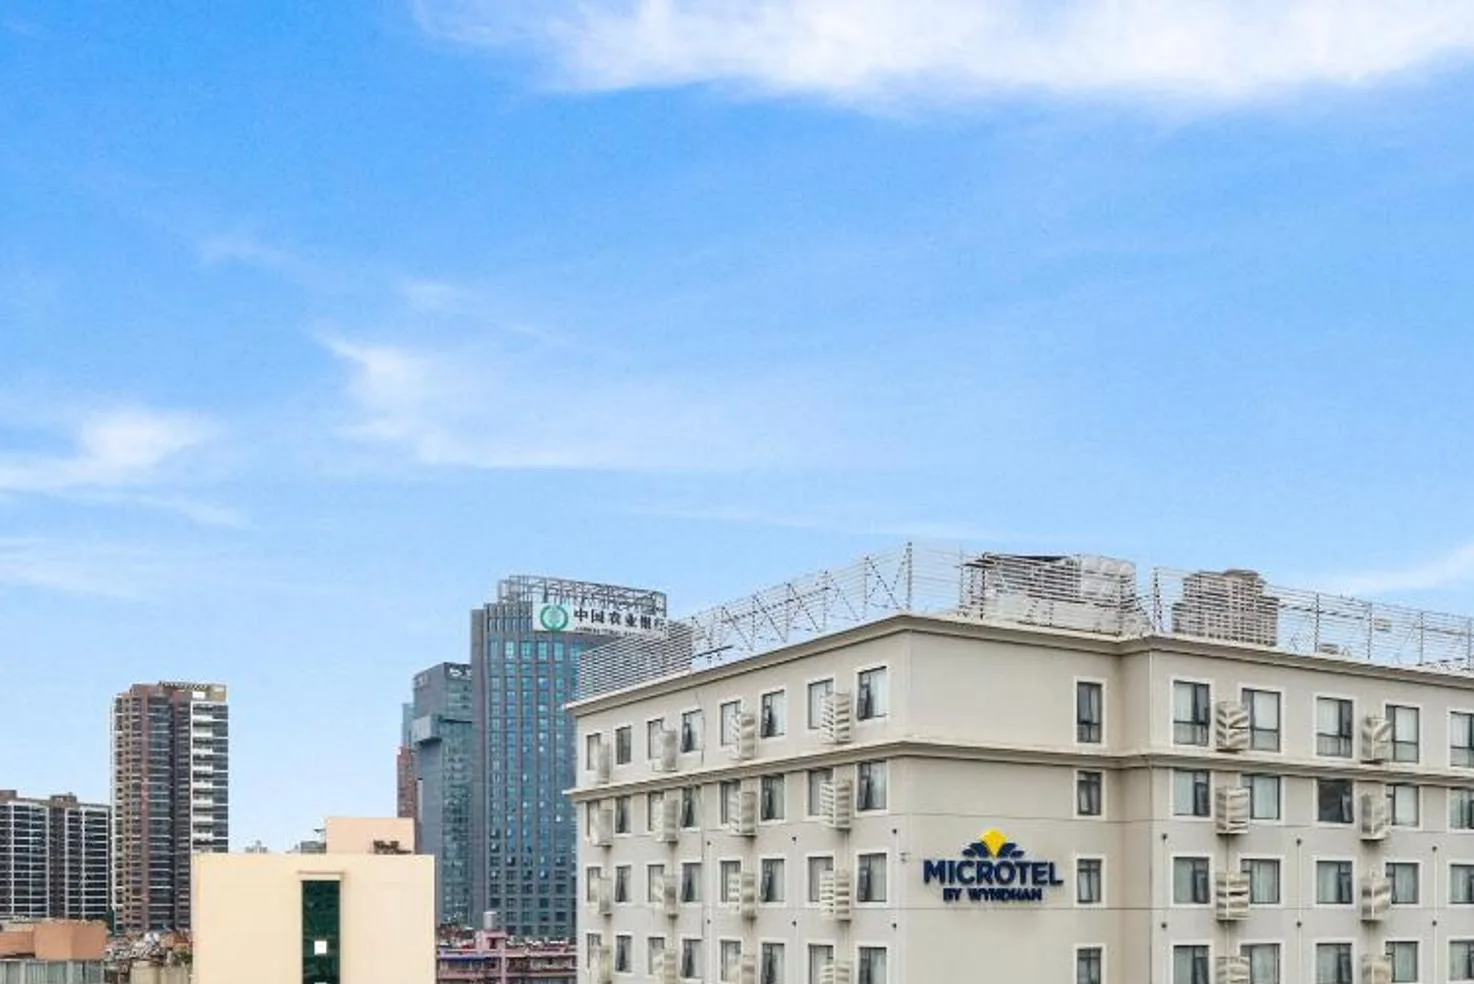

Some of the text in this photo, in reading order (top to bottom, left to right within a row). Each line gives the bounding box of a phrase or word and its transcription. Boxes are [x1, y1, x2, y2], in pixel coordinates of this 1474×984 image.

[923, 859, 1064, 886] MICROTEL
[943, 887, 1042, 903] BY WYNDHAM
